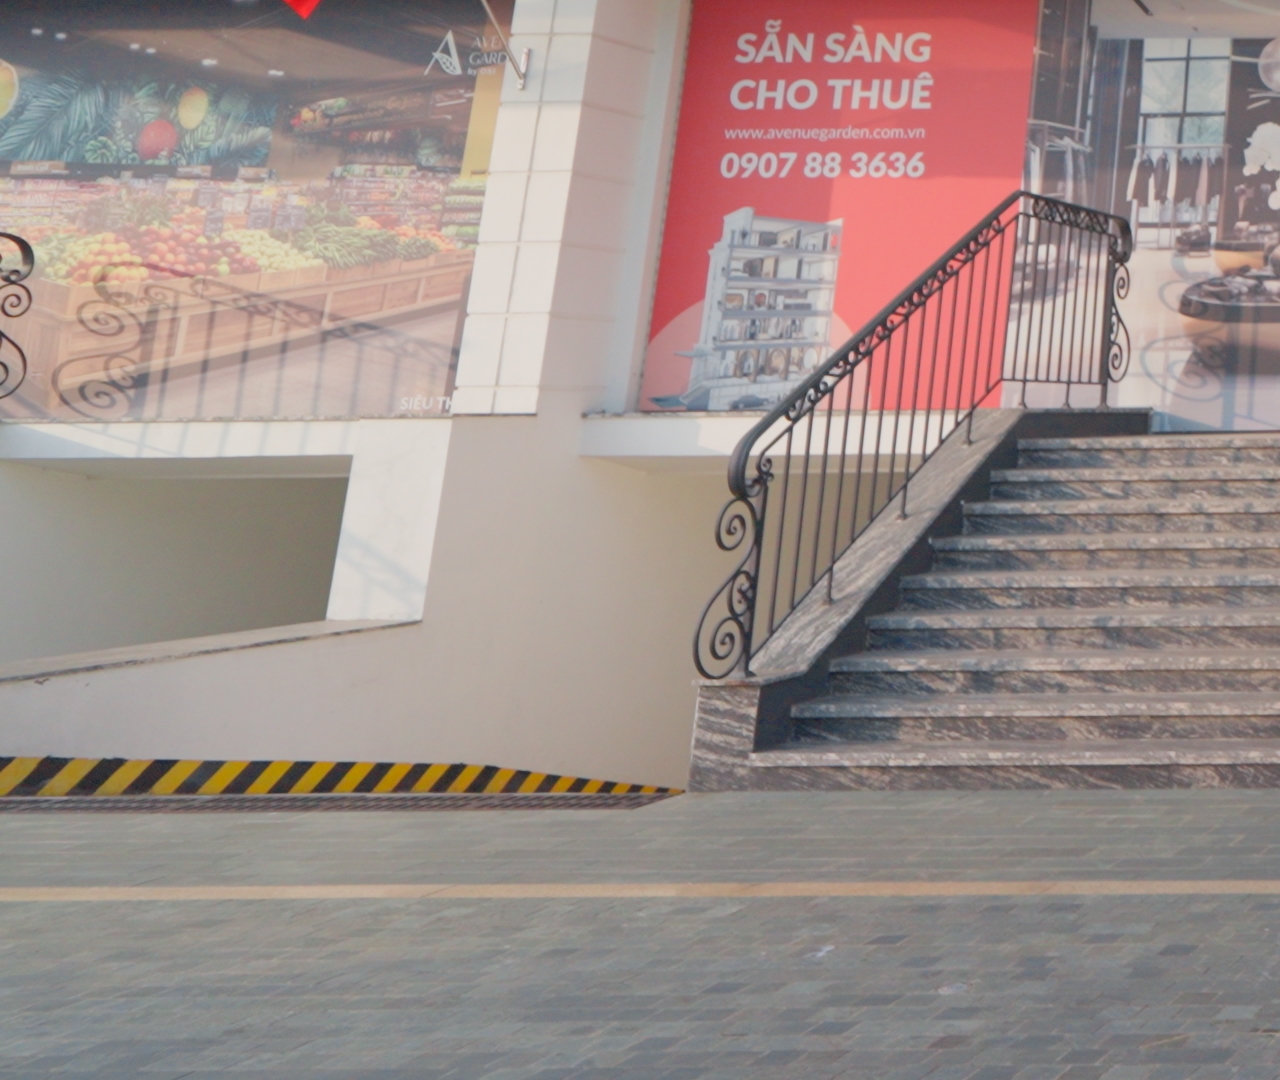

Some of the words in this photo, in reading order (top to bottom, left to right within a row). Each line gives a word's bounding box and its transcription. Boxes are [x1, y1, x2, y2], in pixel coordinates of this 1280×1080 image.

[470, 35, 503, 49] AVE
[734, 19, 814, 63] SẴN
[823, 24, 932, 63] SÀNG
[729, 79, 818, 110] CHO
[827, 71, 934, 110] THUÊ
[724, 125, 926, 142] www.avenuegarden.com.vn
[720, 152, 797, 178] 0907
[803, 152, 842, 178] 88
[849, 152, 926, 178] 3636
